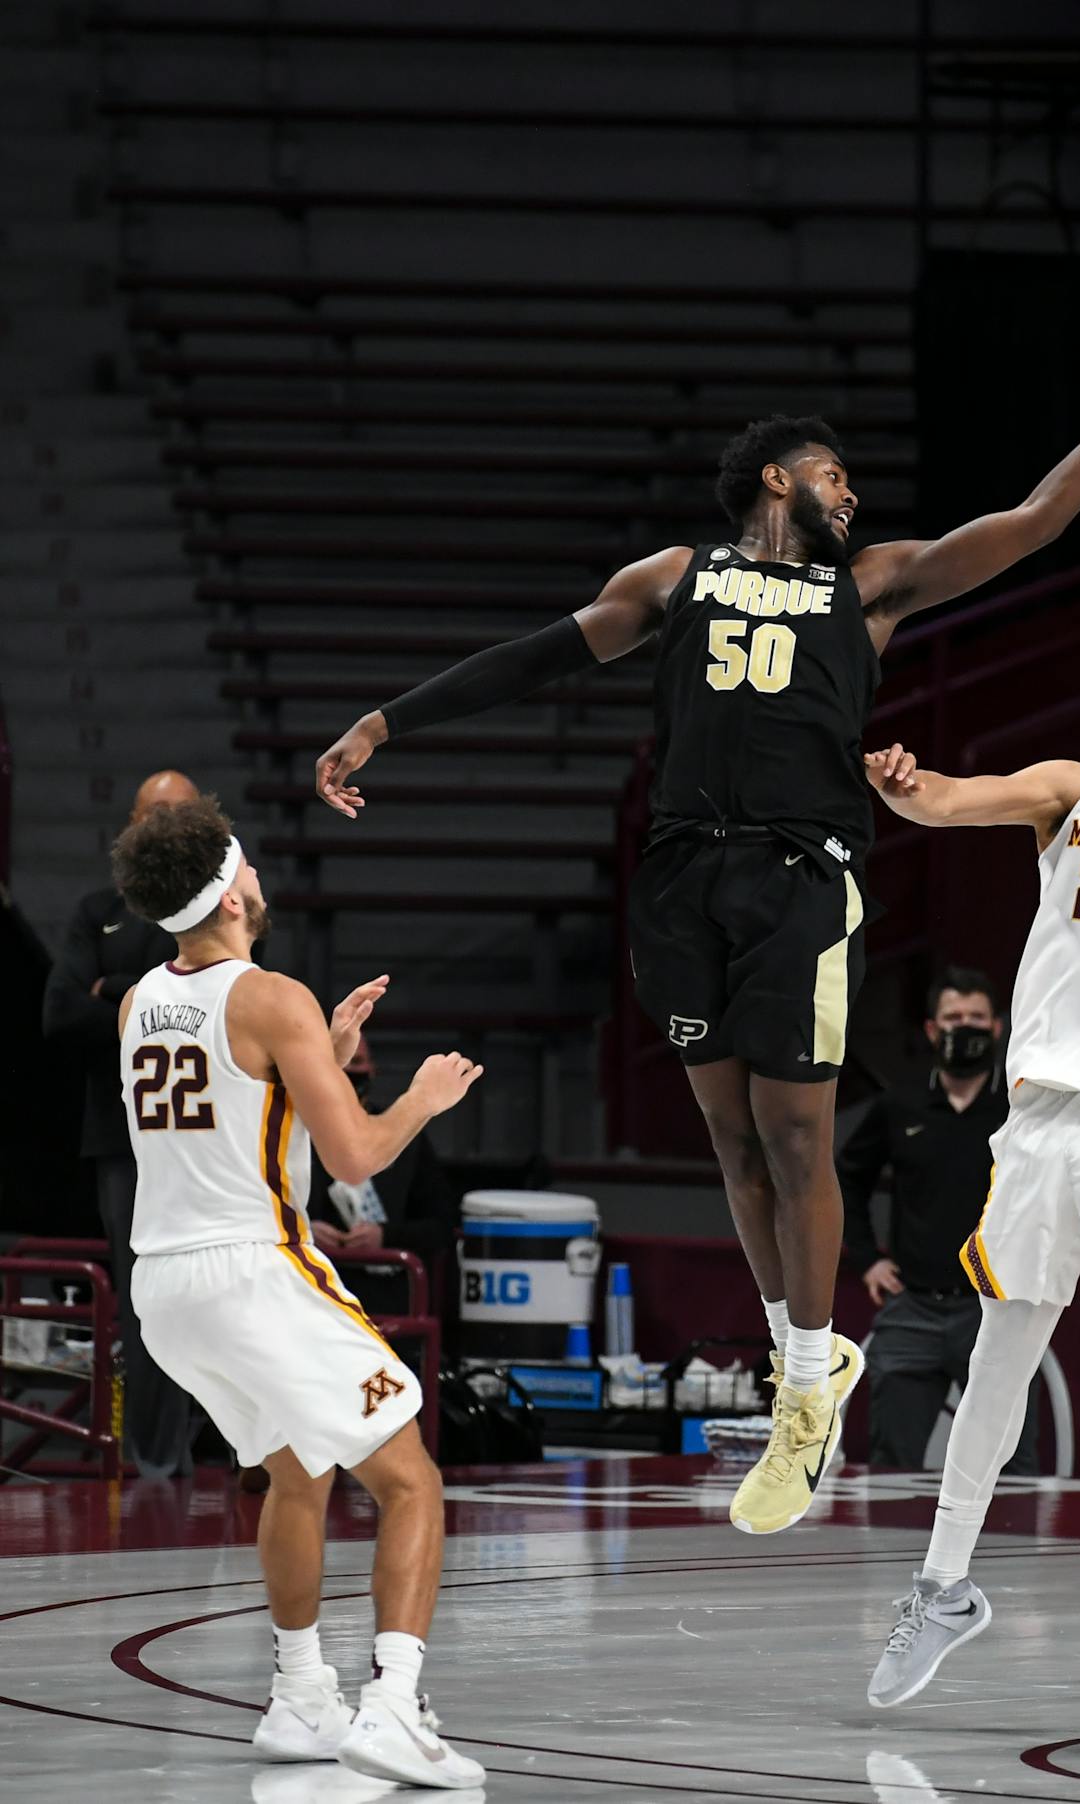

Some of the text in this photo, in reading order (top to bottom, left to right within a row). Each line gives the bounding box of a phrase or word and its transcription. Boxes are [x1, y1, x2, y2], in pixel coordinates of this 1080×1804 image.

[693, 567, 835, 617] PURDUE
[706, 619, 797, 694] 50
[140, 1004, 207, 1039] KALSCHEUR
[668, 1014, 709, 1048] P
[132, 1045, 216, 1131] 22
[358, 1366, 406, 1419] M
